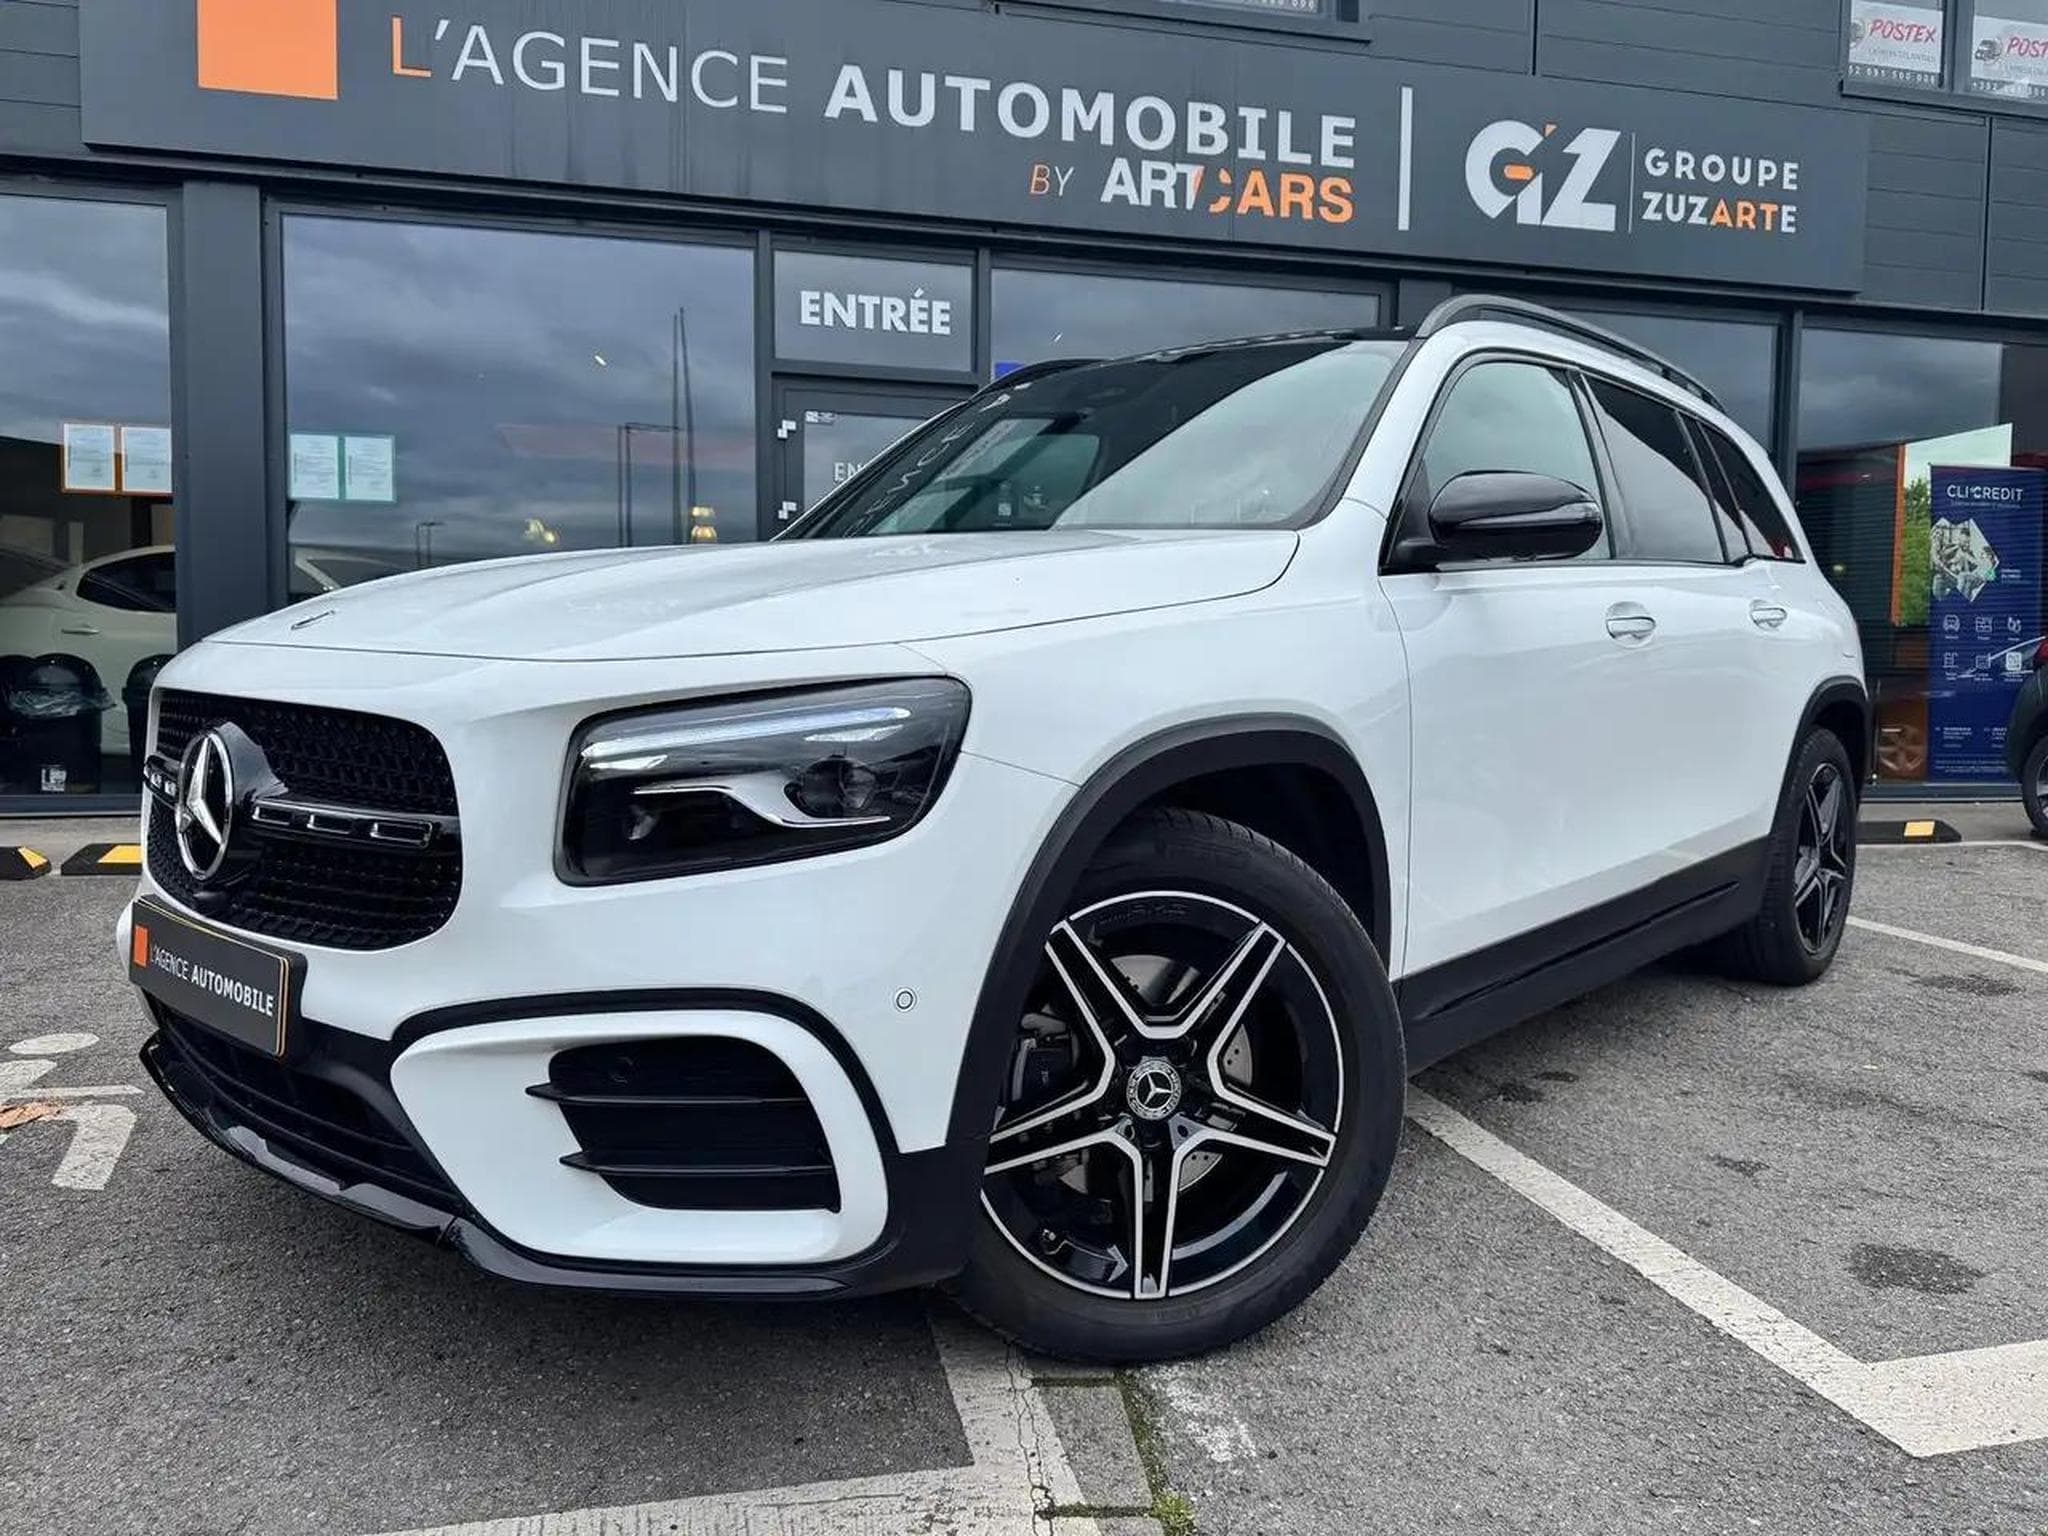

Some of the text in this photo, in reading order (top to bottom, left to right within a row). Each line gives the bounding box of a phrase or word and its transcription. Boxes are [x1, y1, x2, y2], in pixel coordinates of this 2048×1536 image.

[1869, 19, 1937, 43] POSTEX
[391, 15, 1356, 168] L'AGENCE AUTOMOBILE
[1029, 163, 1075, 197] BY
[1644, 148, 1799, 190] GROUPE
[1642, 191, 1797, 233] ZUZARTE
[800, 288, 952, 336] ENTRÉE
[191, 964, 274, 1017] AUTOMOBILE
